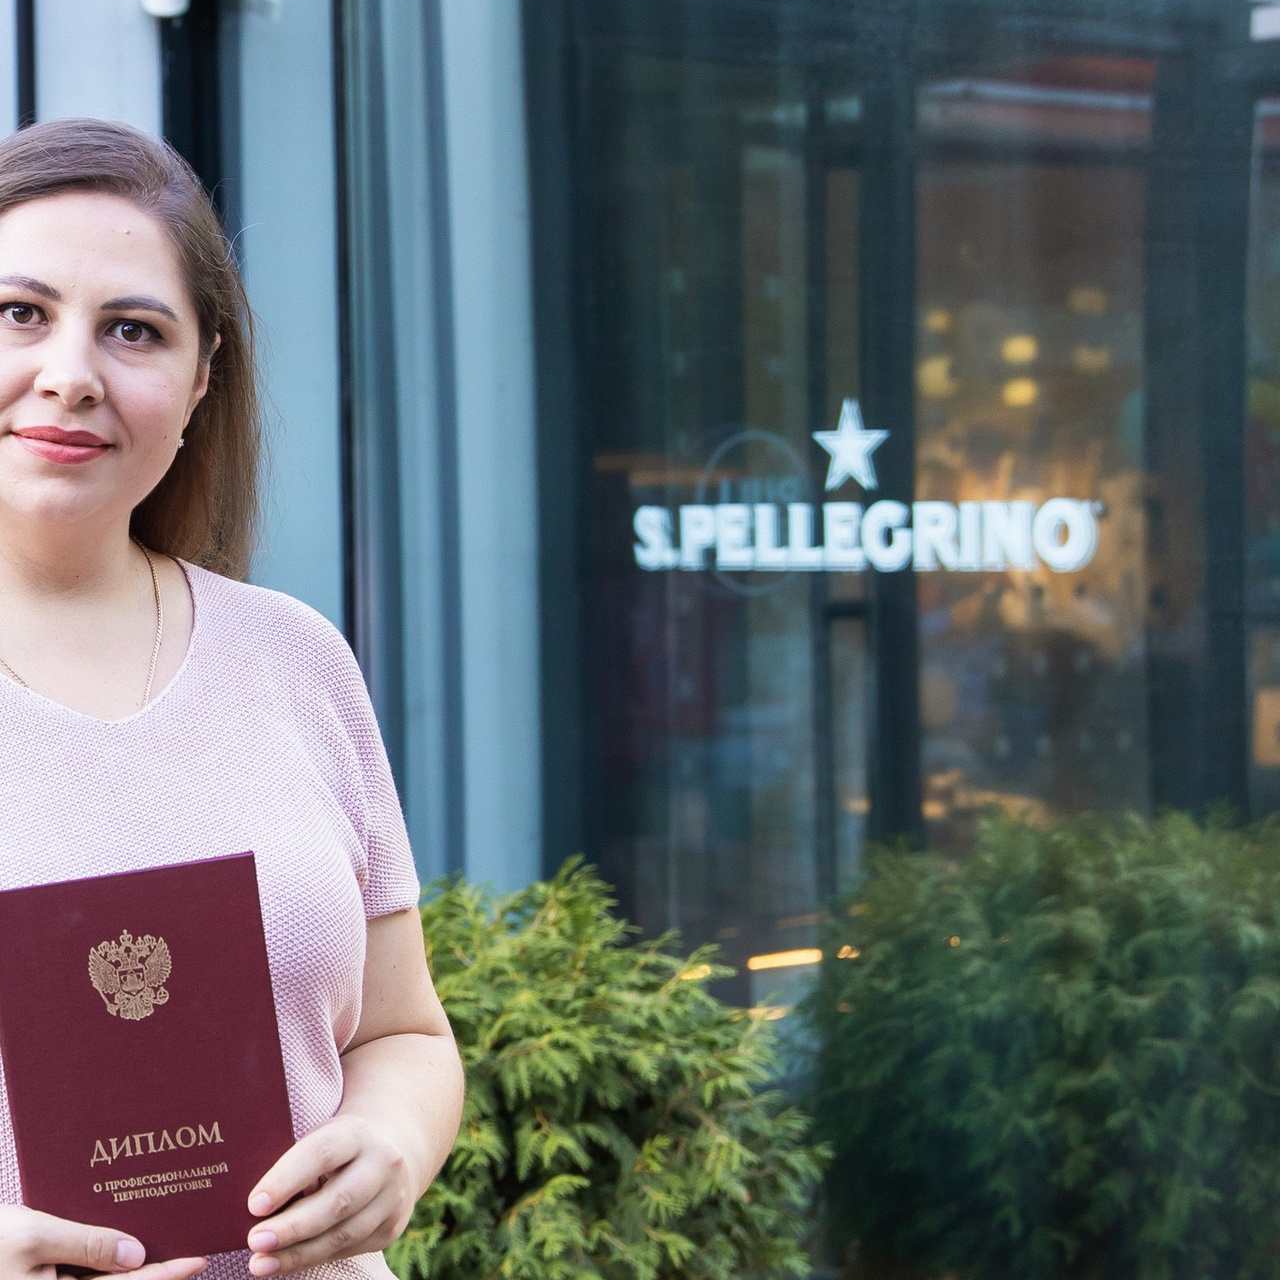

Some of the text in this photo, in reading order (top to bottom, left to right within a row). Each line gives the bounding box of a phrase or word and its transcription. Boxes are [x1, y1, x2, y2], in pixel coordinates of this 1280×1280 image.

[90, 1121, 225, 1168] ДИПЛОМ
[92, 1161, 229, 1193] О ПРОФЕССИОНАЛЬНОЙ
[113, 1178, 213, 1203] ПЕРЕПОДГОТОВКЕ
